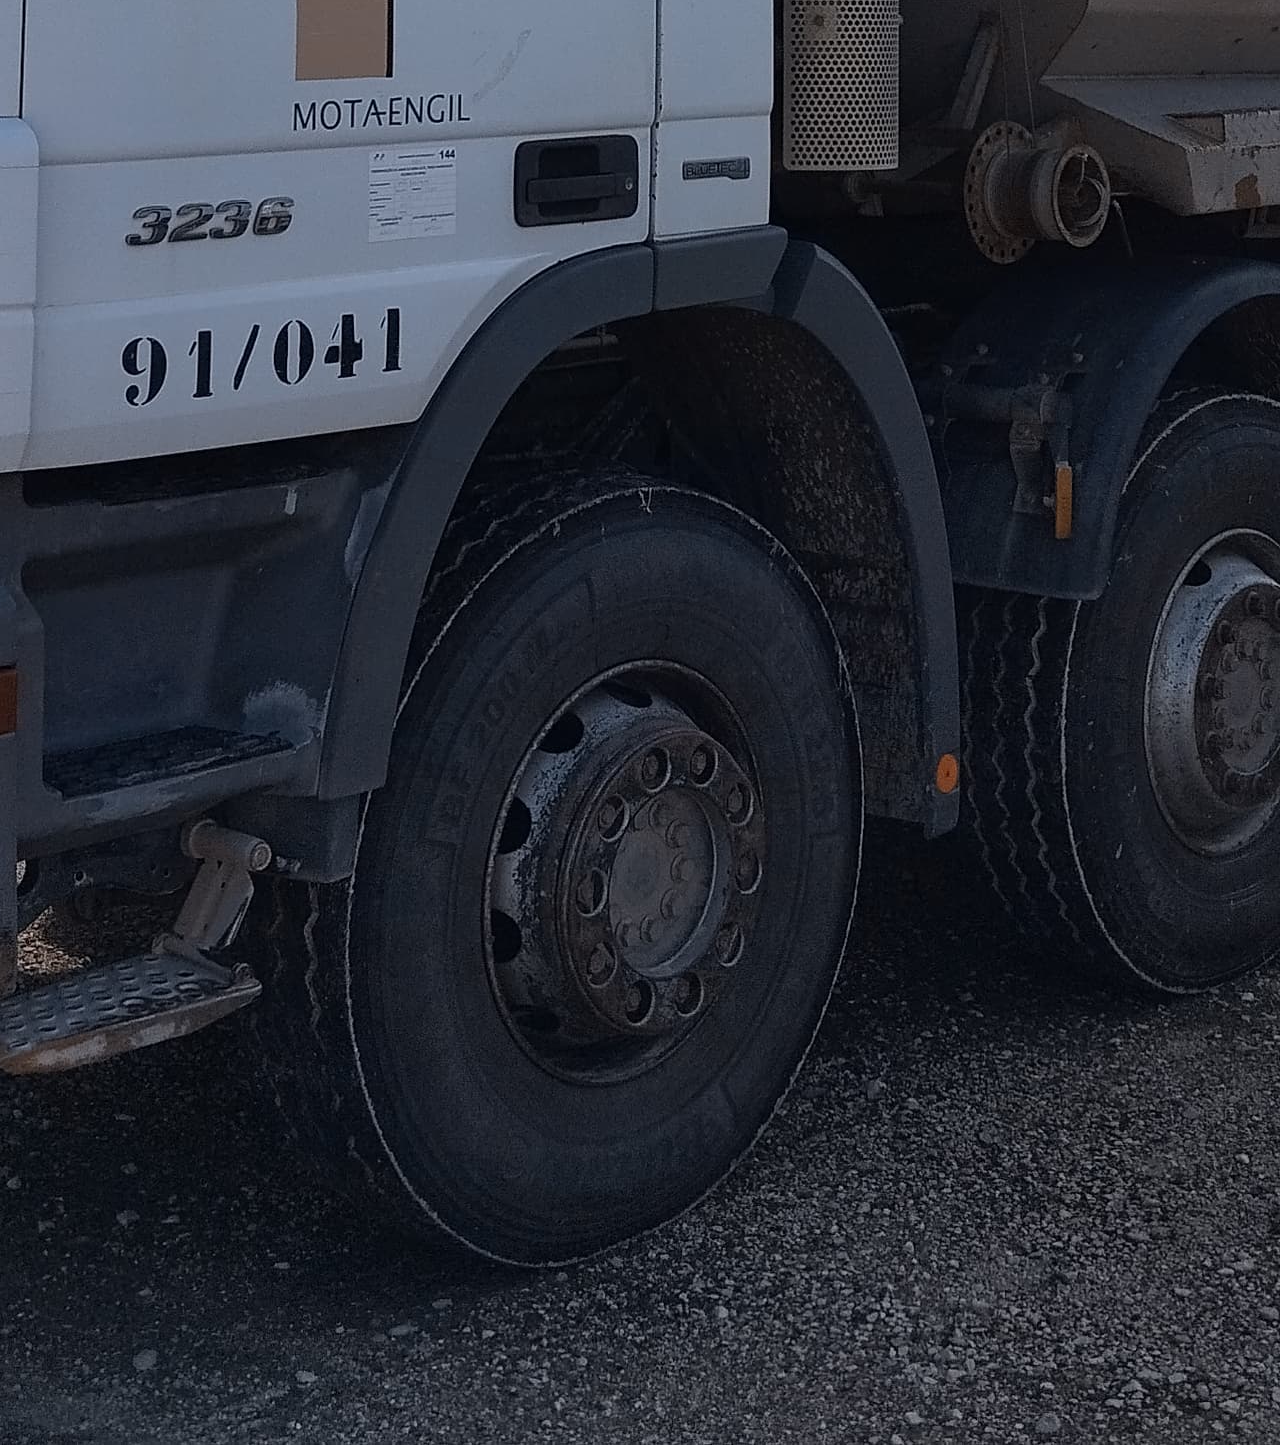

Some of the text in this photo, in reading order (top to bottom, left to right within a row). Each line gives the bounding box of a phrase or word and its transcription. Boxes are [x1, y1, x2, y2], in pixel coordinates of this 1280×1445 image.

[439, 149, 456, 159] 144
[125, 197, 294, 246] 3236
[121, 307, 402, 407] 91/041
